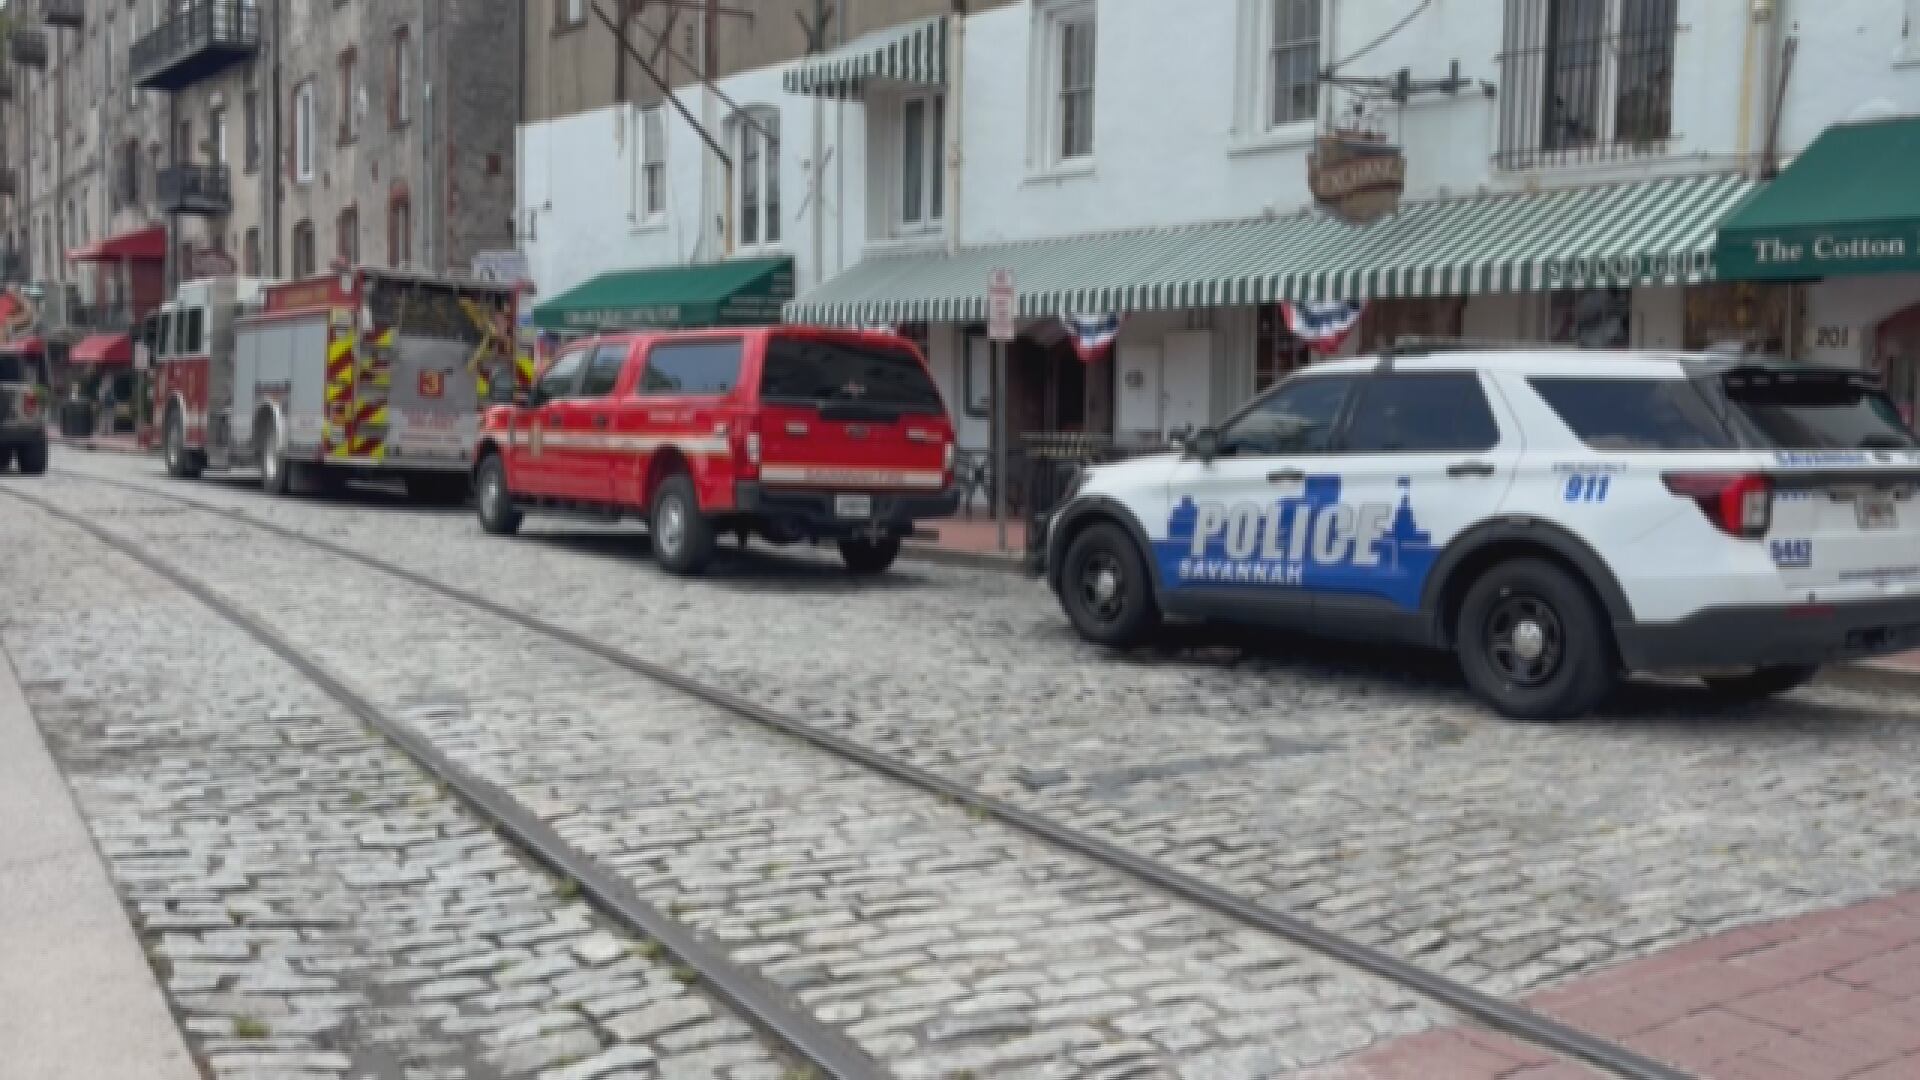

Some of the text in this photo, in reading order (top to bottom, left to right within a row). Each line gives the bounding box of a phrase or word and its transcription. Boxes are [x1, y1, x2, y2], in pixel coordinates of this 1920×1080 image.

[1753, 235, 1906, 263] The Cotton
[1816, 325, 1850, 348] 201
[422, 369, 440, 396] 3
[1563, 472, 1611, 503] 911
[1190, 500, 1394, 566] POLICE
[1179, 558, 1303, 586] SAVANNAH
